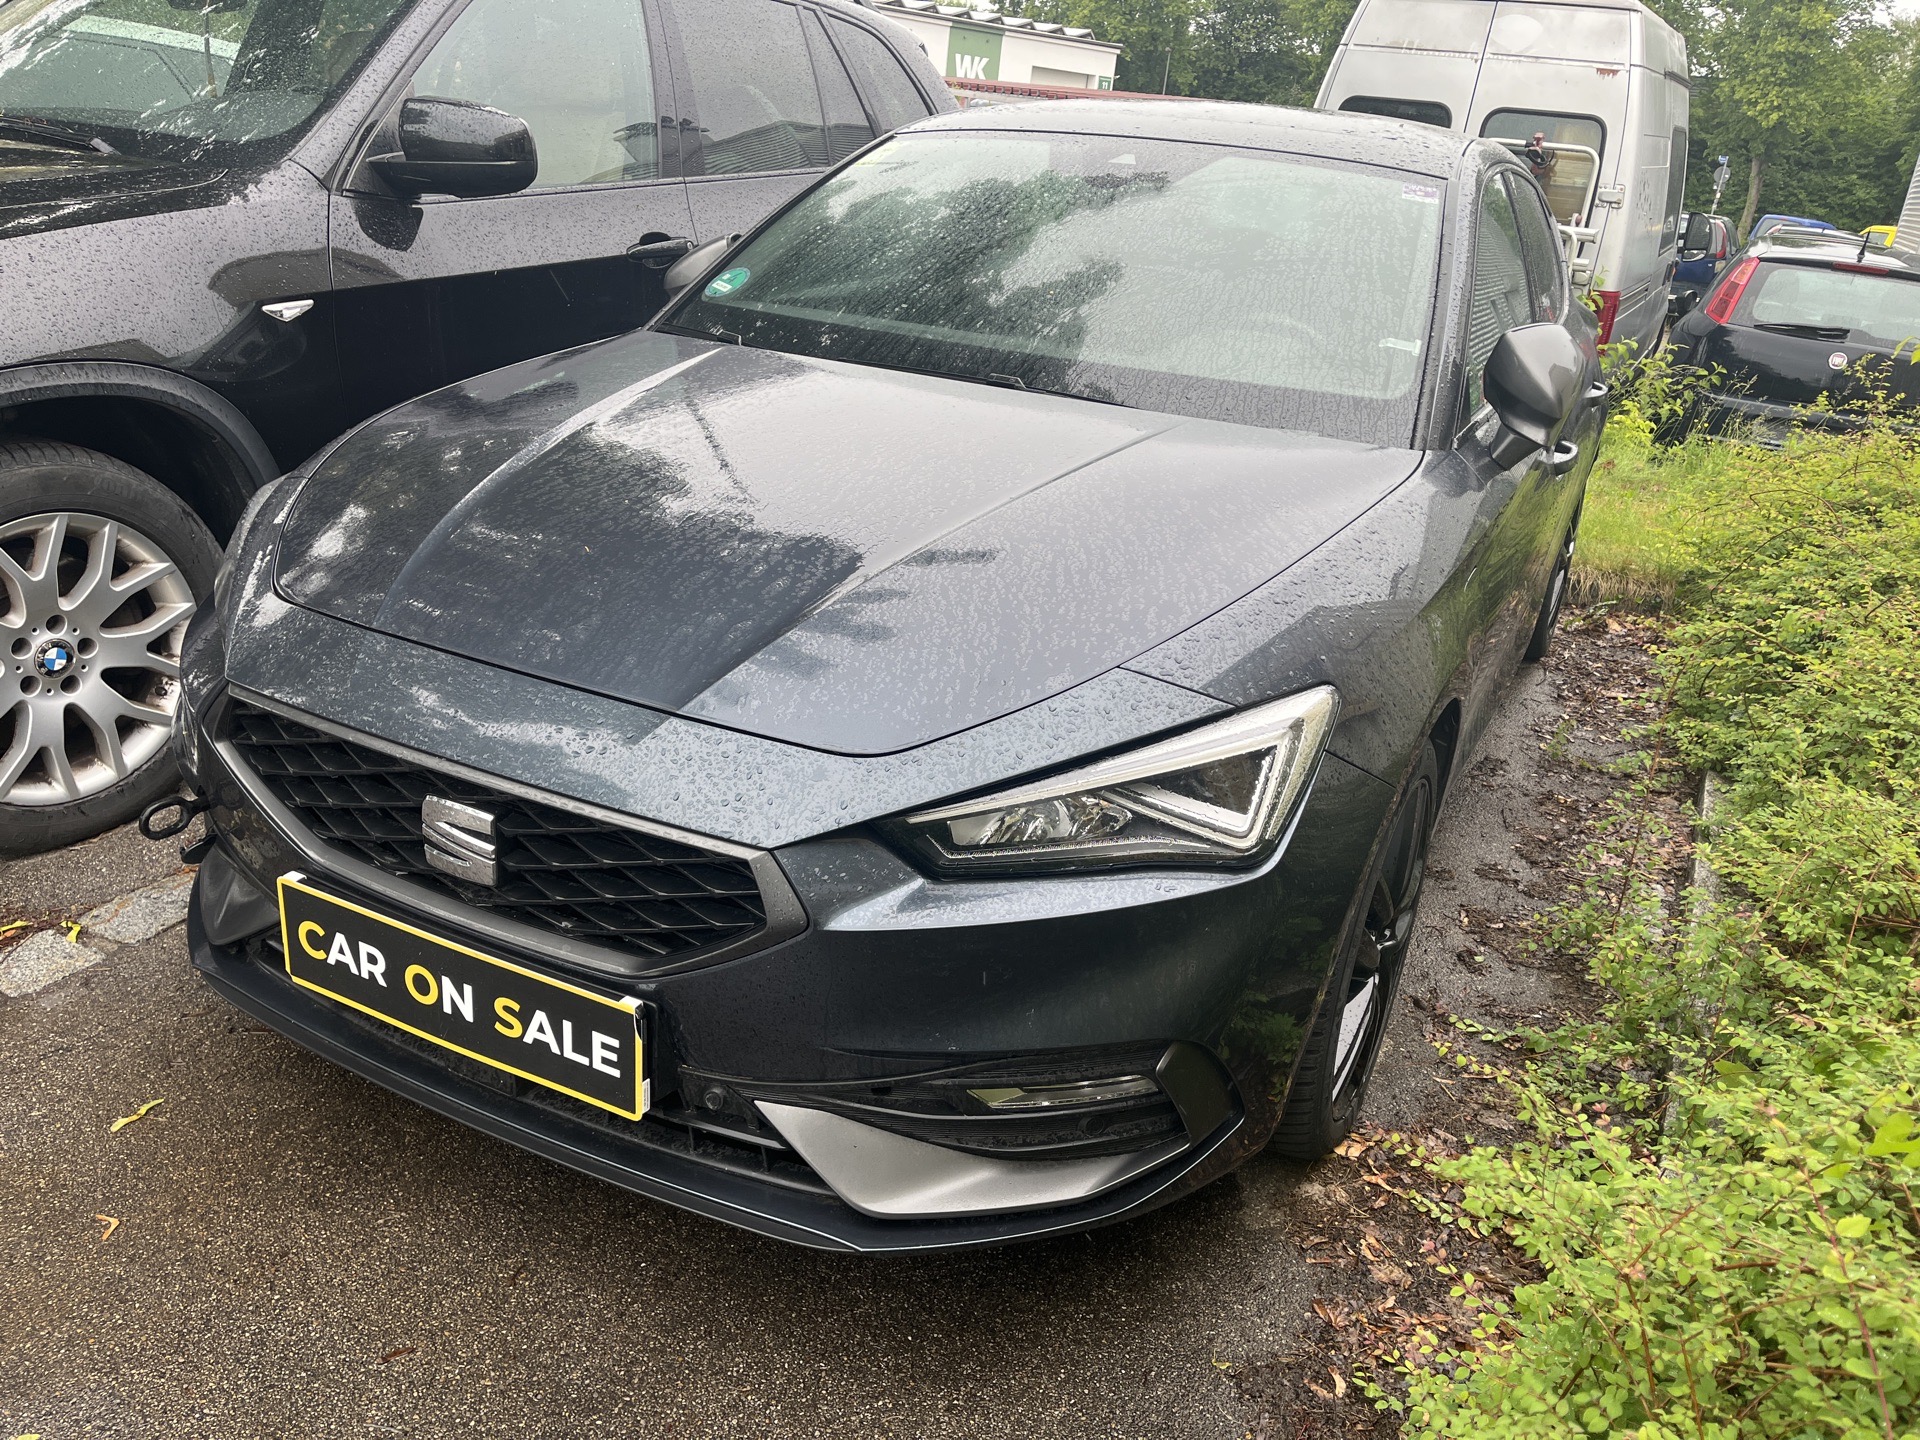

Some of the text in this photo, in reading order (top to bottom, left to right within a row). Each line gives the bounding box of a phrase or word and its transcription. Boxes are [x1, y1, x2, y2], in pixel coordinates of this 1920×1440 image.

[955, 53, 990, 80] WK
[298, 920, 622, 1078] CAR ON SALE
